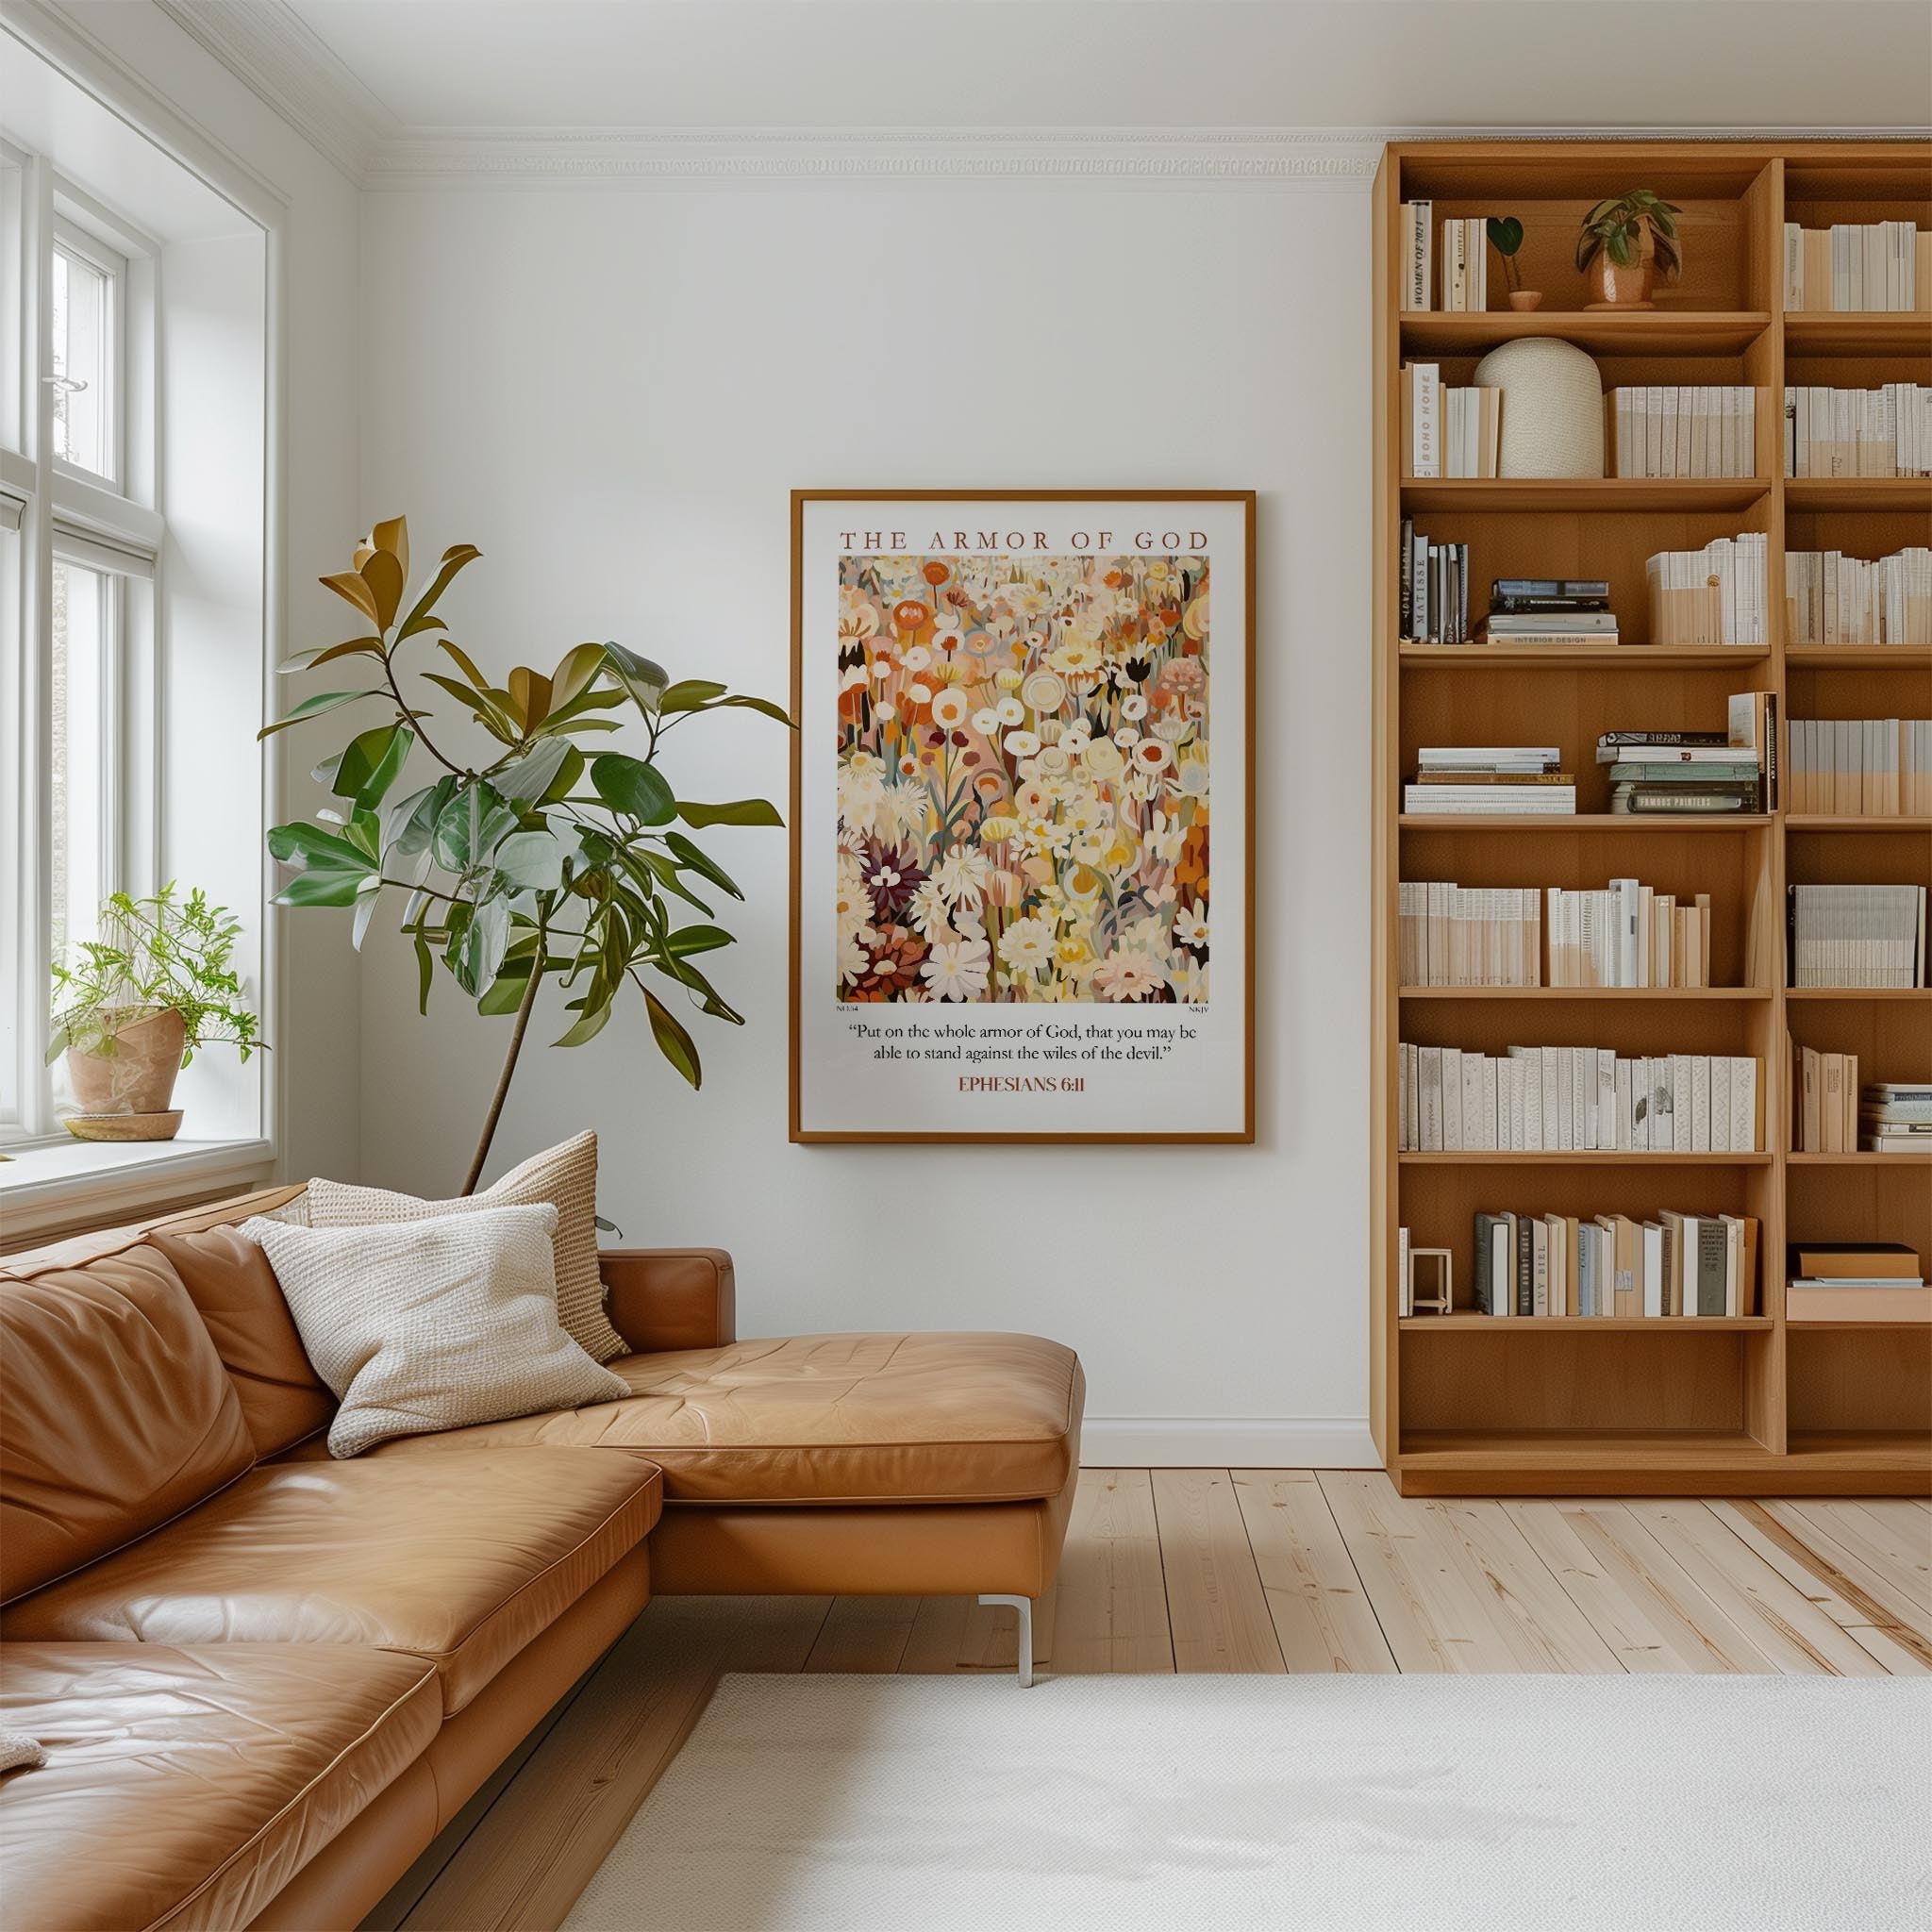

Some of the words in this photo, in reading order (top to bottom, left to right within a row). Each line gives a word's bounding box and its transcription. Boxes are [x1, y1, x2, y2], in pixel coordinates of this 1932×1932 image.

[1415, 220, 1424, 243] 2024
[1415, 244, 1424, 260] OF
[1415, 262, 1424, 305] WOMEN
[1422, 375, 1430, 415] HOME
[1422, 422, 1430, 461] BOHO
[840, 531, 907, 550] THE
[928, 531, 1050, 550] ARMOR
[1071, 531, 1113, 550] OF
[1135, 531, 1208, 550] GOD
[1416, 559, 1425, 625] MATISSE
[1514, 636, 1554, 644] INTERIOR
[1556, 636, 1587, 644] DESIGN
[1674, 797, 1711, 808] PAINTERS
[1189, 1006, 1209, 1014] NKJV
[885, 1027, 904, 1039] on
[907, 1024, 930, 1039] the
[933, 1024, 976, 1039] whole
[979, 1027, 1024, 1039] armor
[1025, 1024, 1044, 1039] of
[1045, 1024, 1082, 1041] God,
[1085, 1024, 1114, 1040] that
[1116, 1027, 1143, 1042] you
[1146, 1027, 1175, 1042] may
[1179, 1024, 1197, 1040] be
[873, 1044, 903, 1059] able
[906, 1046, 921, 1059] to
[924, 1045, 961, 1059] stand
[965, 1045, 1014, 1064] against
[1017, 1045, 1040, 1059] the
[1041, 1045, 1078, 1059] wiles
[1080, 1045, 1100, 1059] of
[1101, 1045, 1123, 1059] the
[959, 1076, 1058, 1092] EPHESIANS
[1060, 1077, 1085, 1092] 6:11
